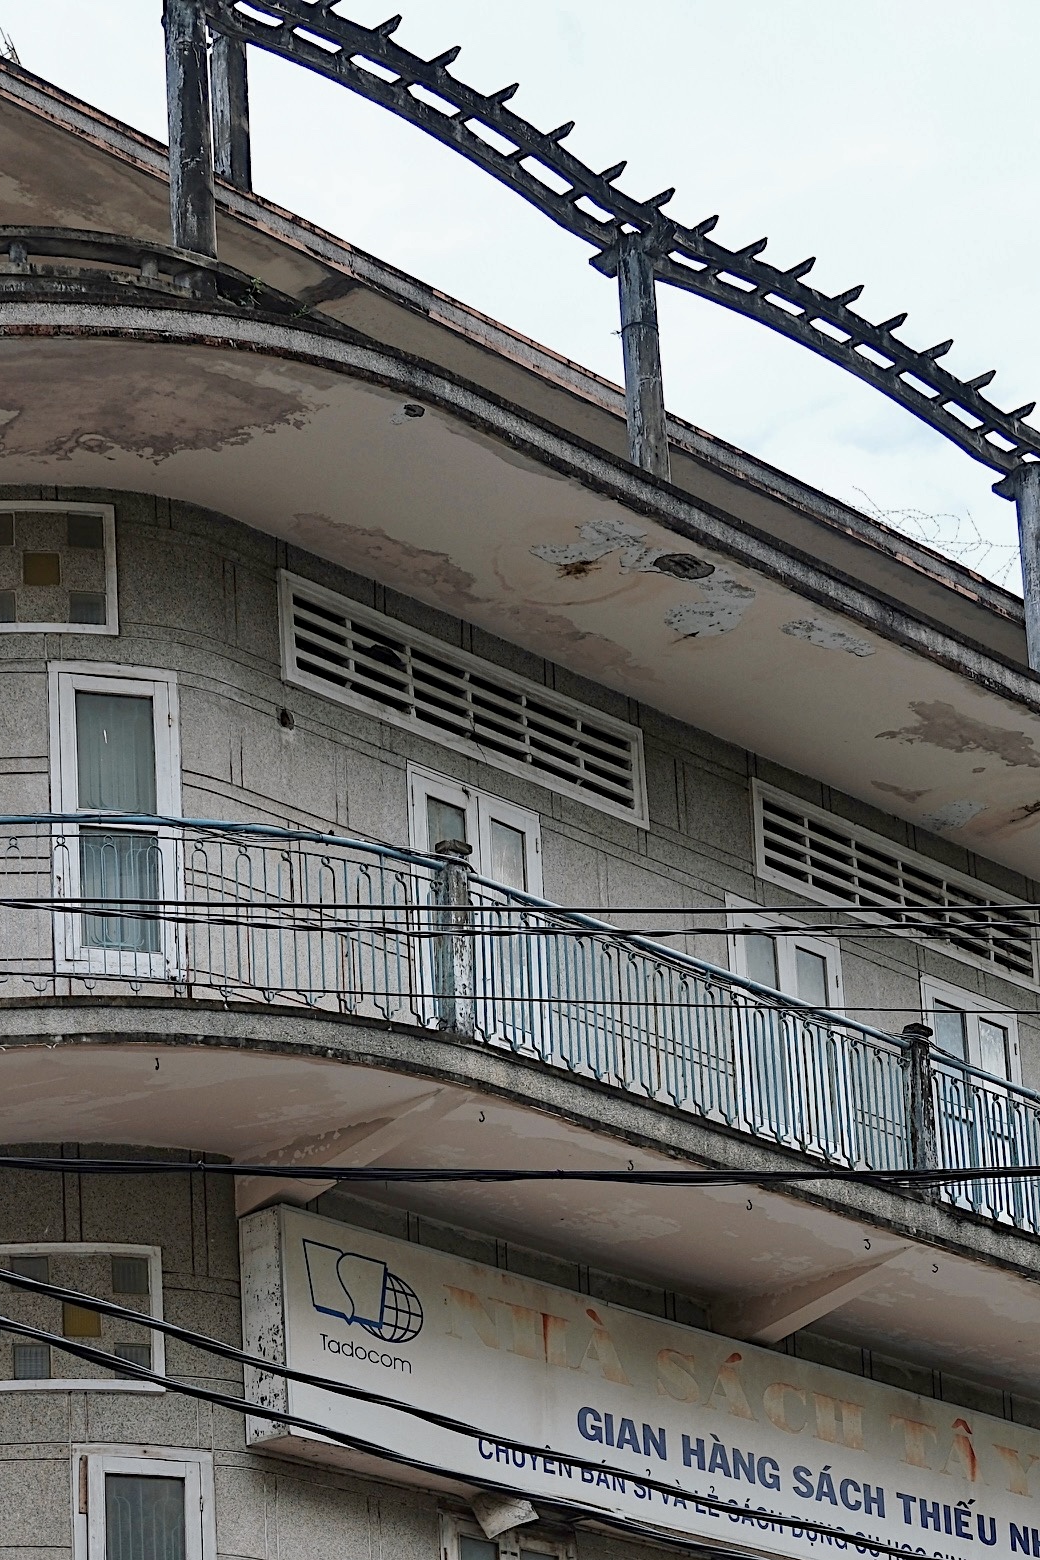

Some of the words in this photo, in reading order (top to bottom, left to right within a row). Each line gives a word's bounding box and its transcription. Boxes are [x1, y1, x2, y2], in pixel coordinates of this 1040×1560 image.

[319, 1333, 413, 1374] Tadocom
[656, 1348, 864, 1451] SÁCH
[576, 1405, 668, 1461] GIAN
[681, 1433, 781, 1491] HÀNG
[792, 1465, 886, 1518] SÁCH
[895, 1492, 998, 1547] THIẾU
